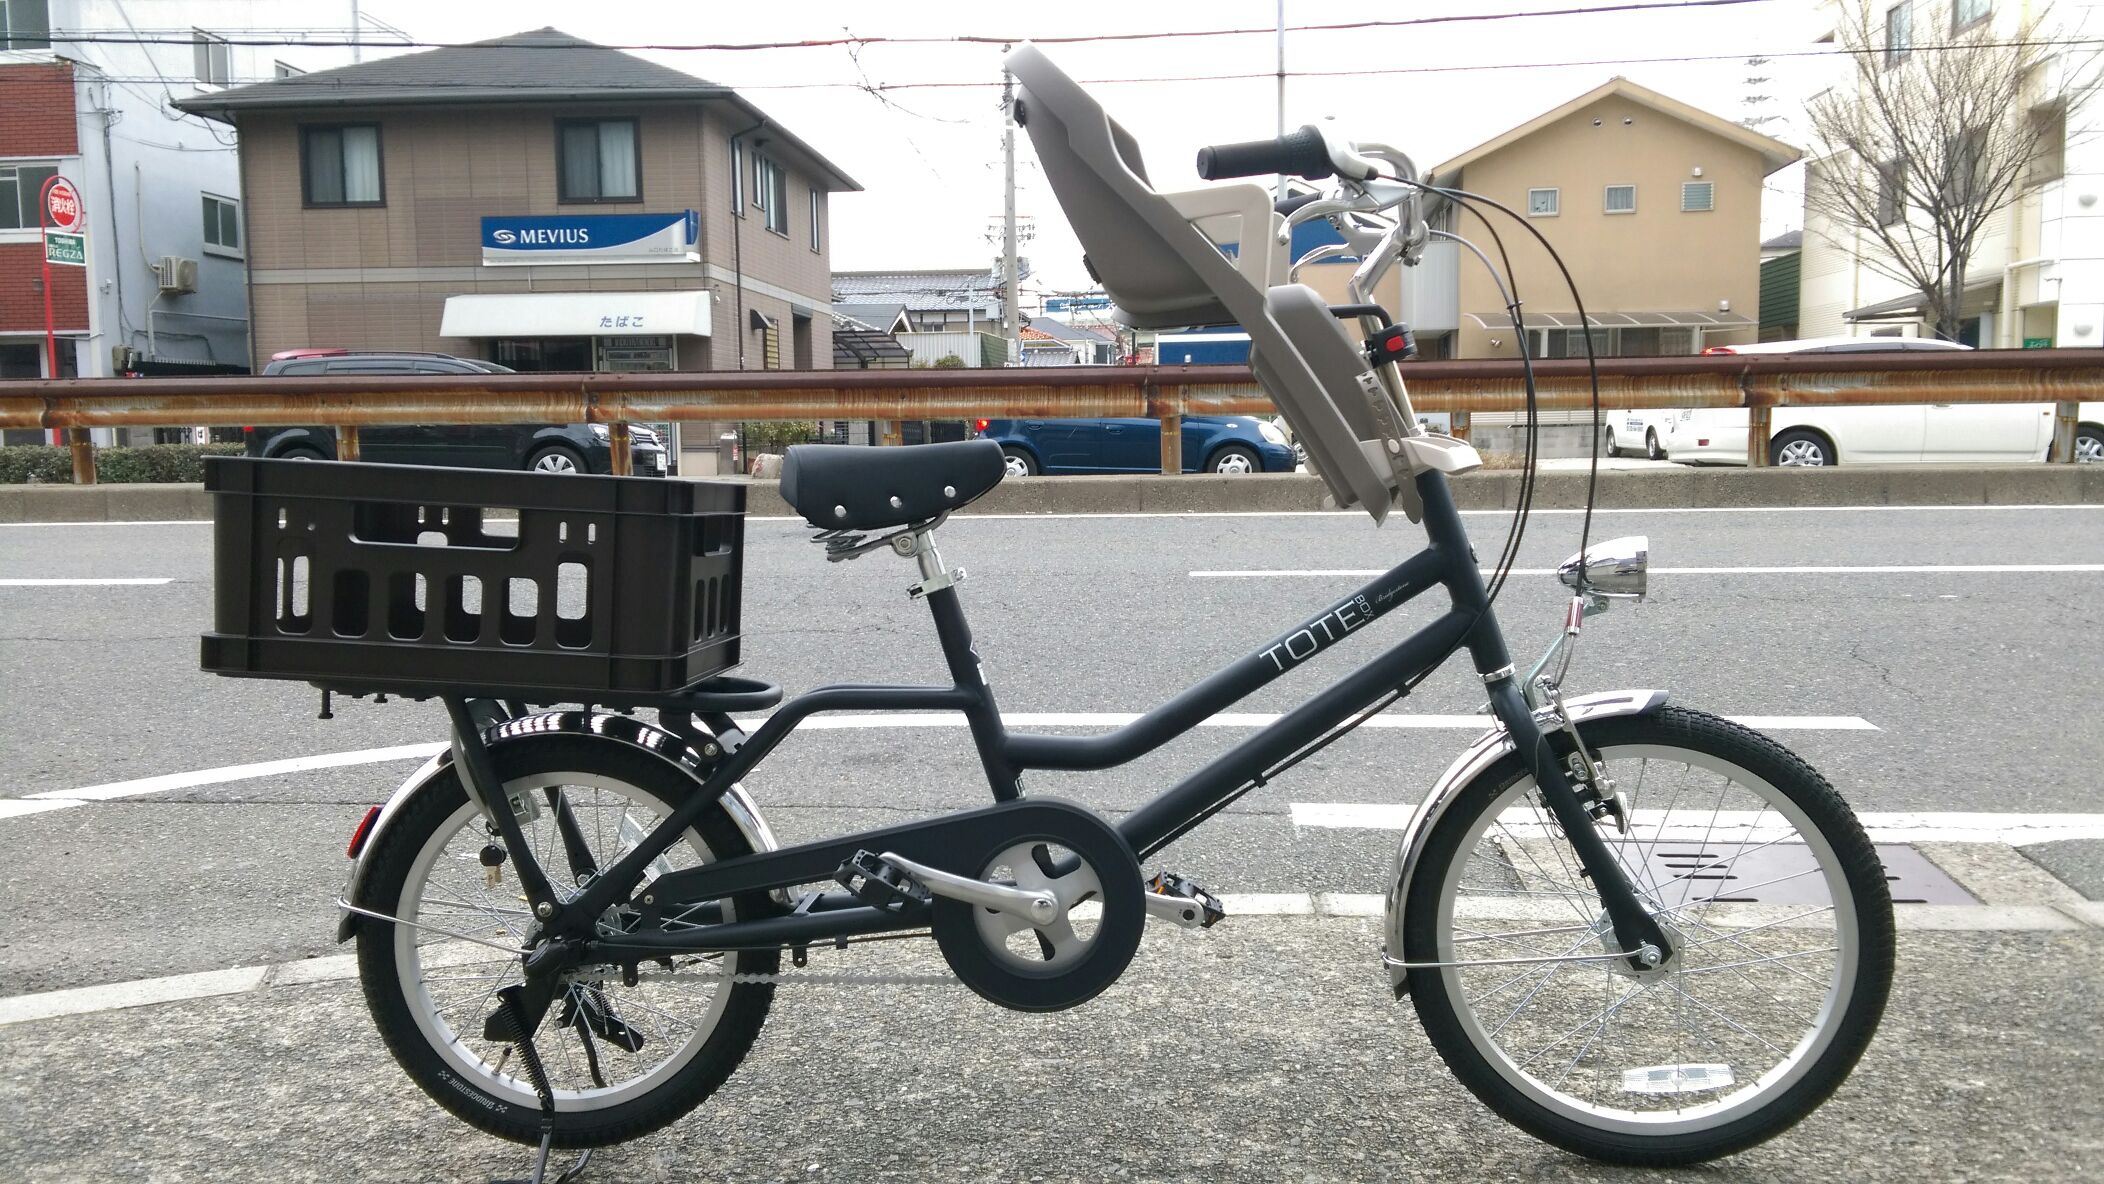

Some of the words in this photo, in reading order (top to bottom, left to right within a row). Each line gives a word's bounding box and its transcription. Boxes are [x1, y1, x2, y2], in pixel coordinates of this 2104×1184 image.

[520, 228, 589, 244] MEVIUS
[49, 248, 83, 259] REGZA
[599, 315, 644, 328] たばこ
[1354, 594, 1375, 620] BOX
[1258, 600, 1366, 671] TOTE
[448, 1078, 495, 1109] BRIDGESTONE
